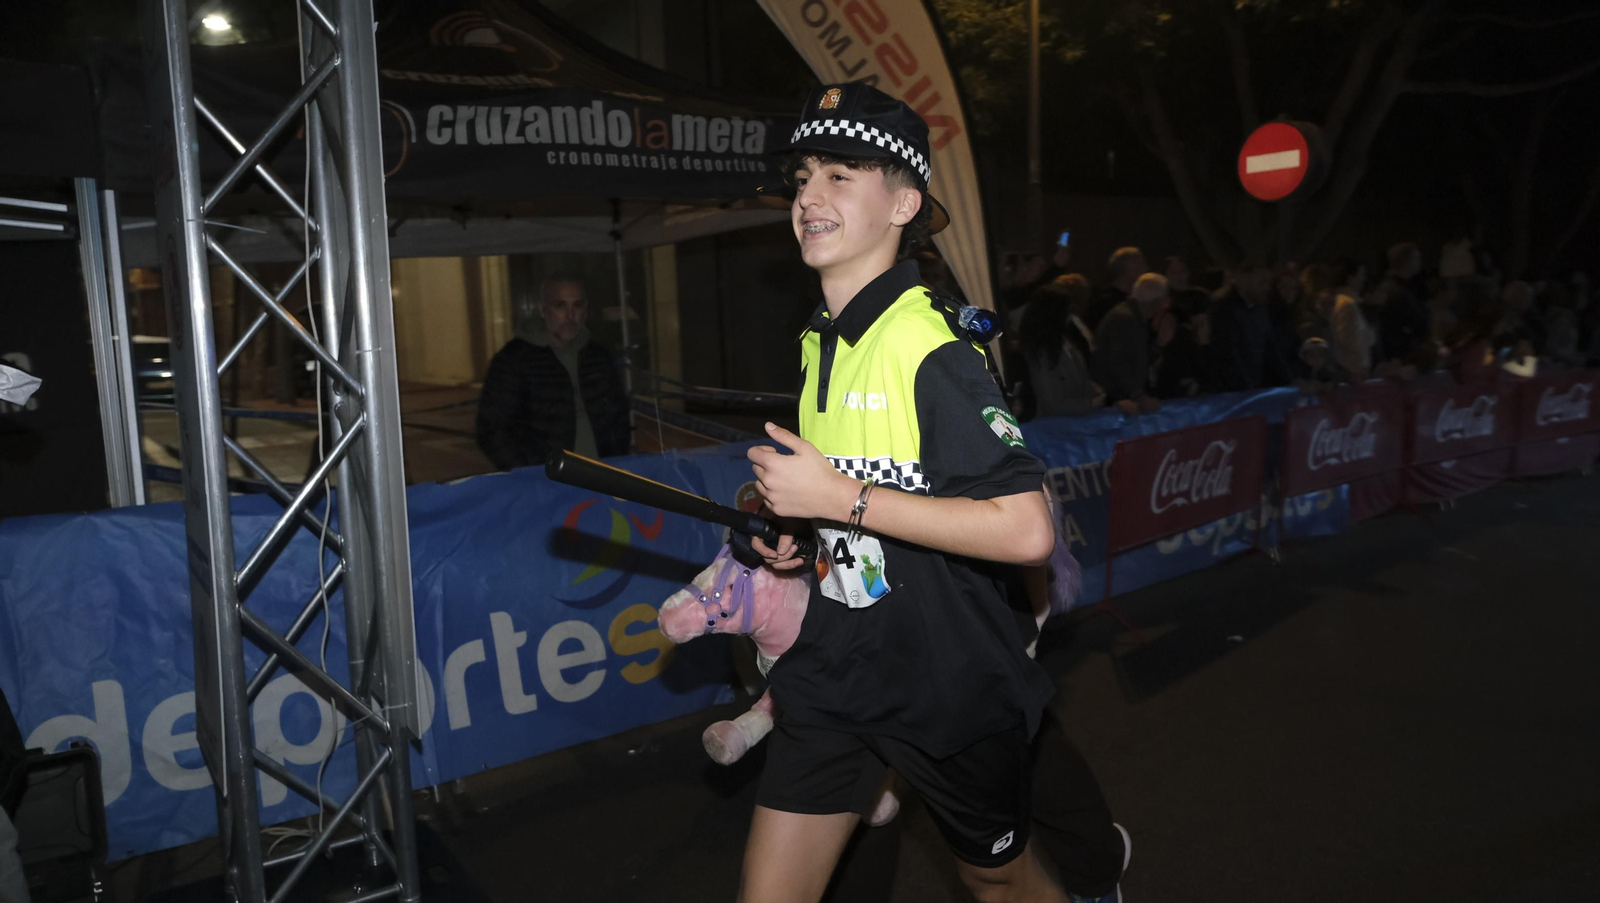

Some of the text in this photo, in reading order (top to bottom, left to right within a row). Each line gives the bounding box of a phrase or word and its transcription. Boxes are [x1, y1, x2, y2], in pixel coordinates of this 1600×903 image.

[547, 150, 767, 172] cronometraje deportivo
[823, 536, 857, 570] 4
[25, 603, 676, 808] deprtes
